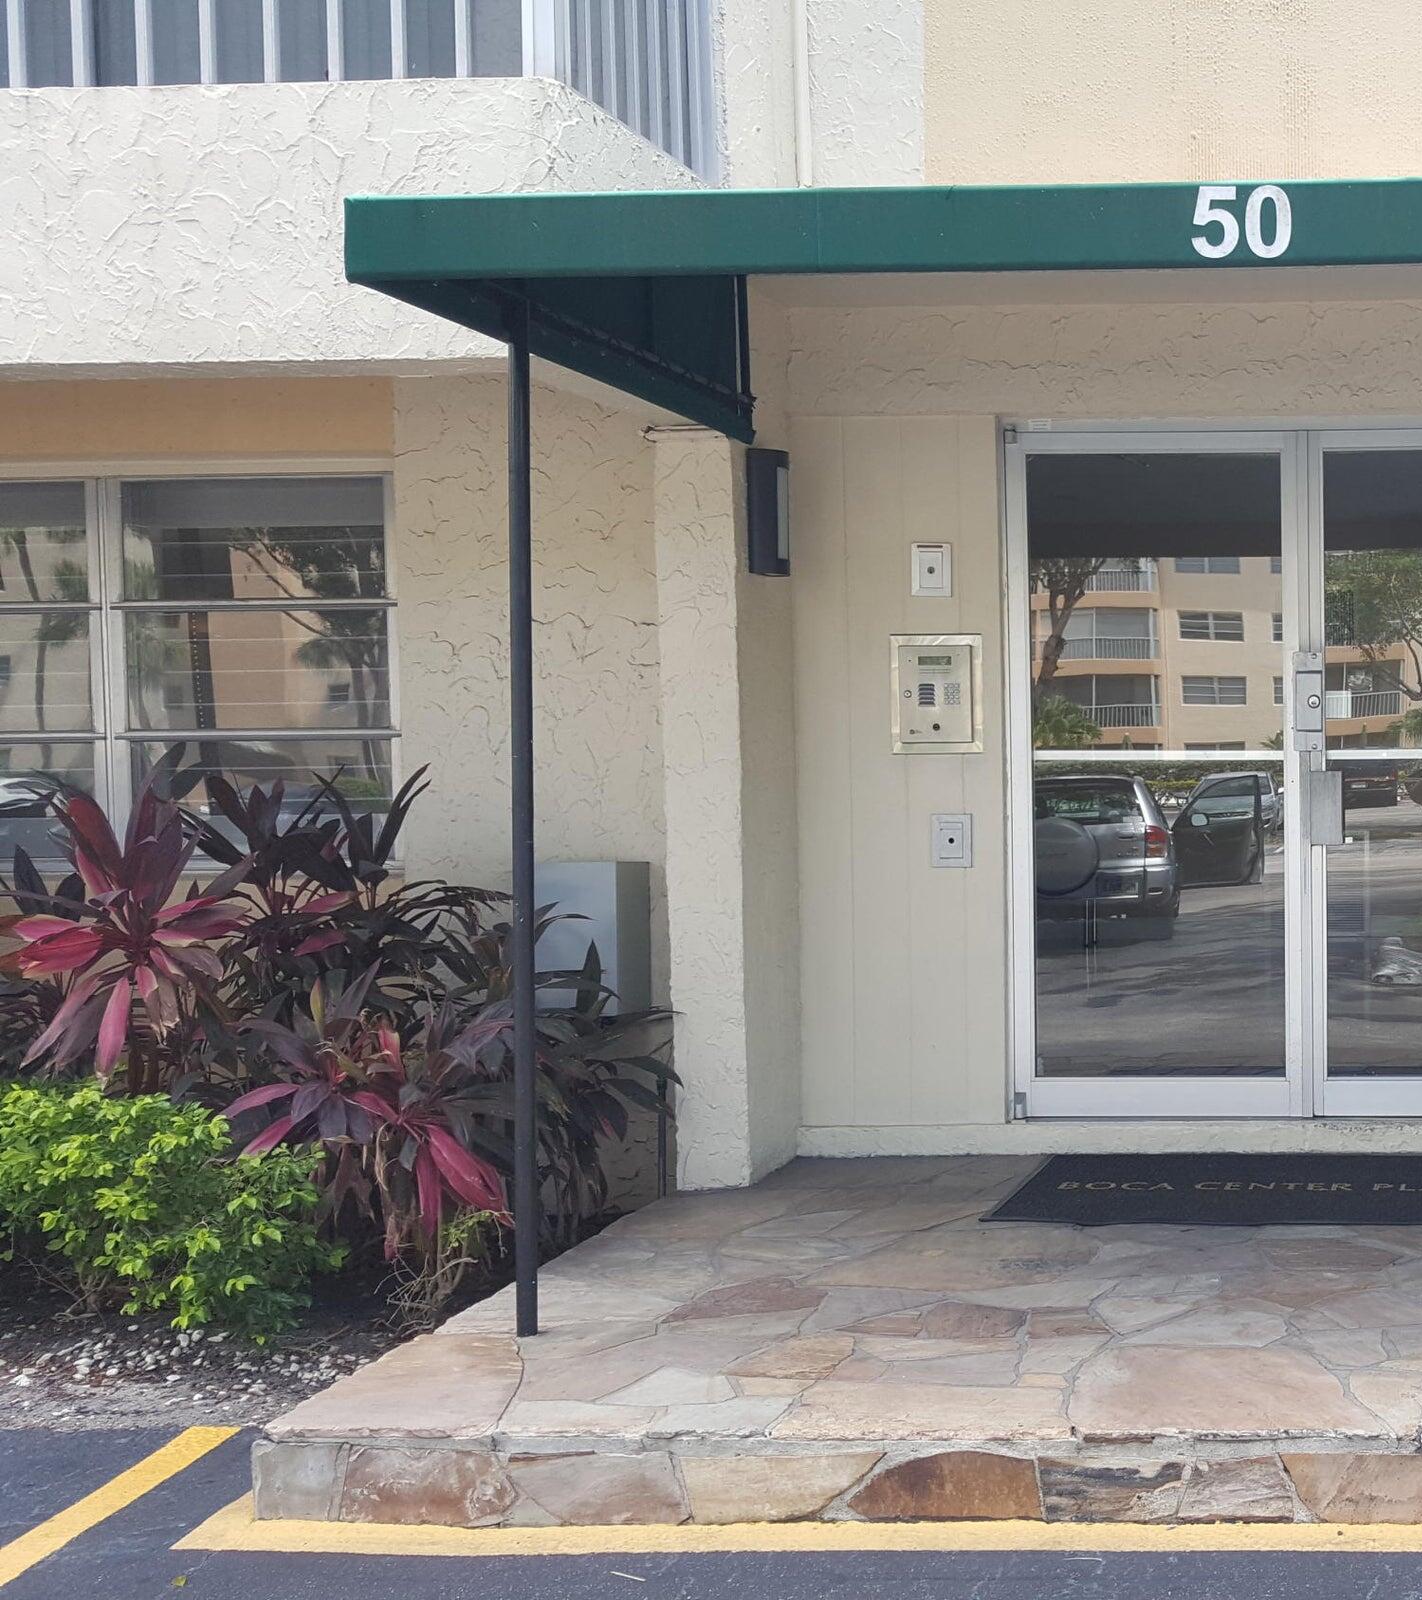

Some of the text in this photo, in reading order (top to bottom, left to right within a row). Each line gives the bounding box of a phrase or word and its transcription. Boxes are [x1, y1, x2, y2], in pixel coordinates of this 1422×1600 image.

[1191, 184, 1292, 259] 50
[1056, 1181, 1176, 1191] BOCA
[1194, 1181, 1353, 1192] CENTER
